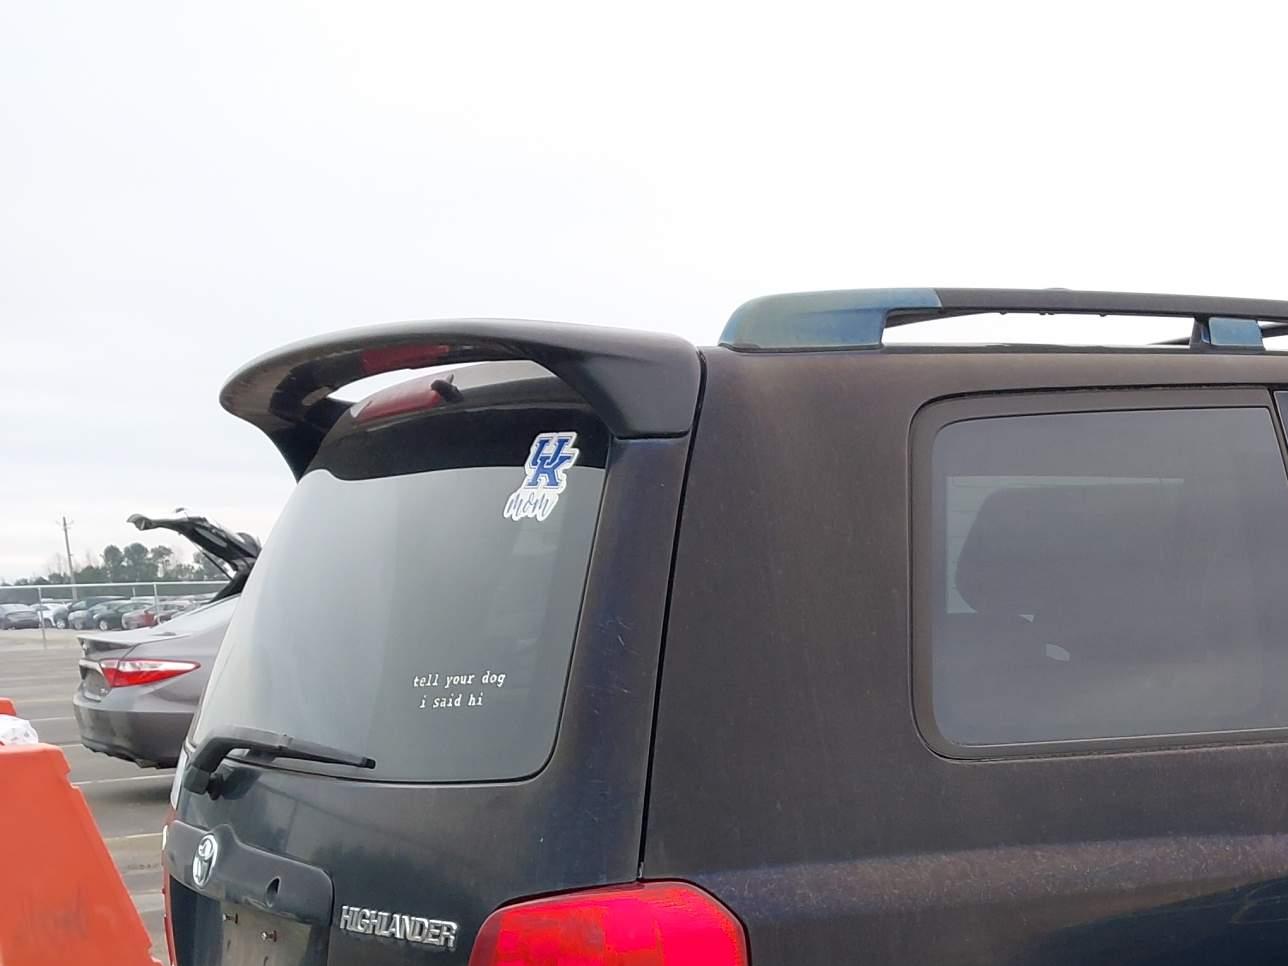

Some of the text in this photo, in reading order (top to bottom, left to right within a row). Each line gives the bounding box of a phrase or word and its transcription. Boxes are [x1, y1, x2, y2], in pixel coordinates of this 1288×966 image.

[526, 436, 575, 489] UK
[413, 670, 506, 689] tell your dog
[419, 691, 484, 708] i said hi
[339, 905, 458, 948] HIGHLANDER
